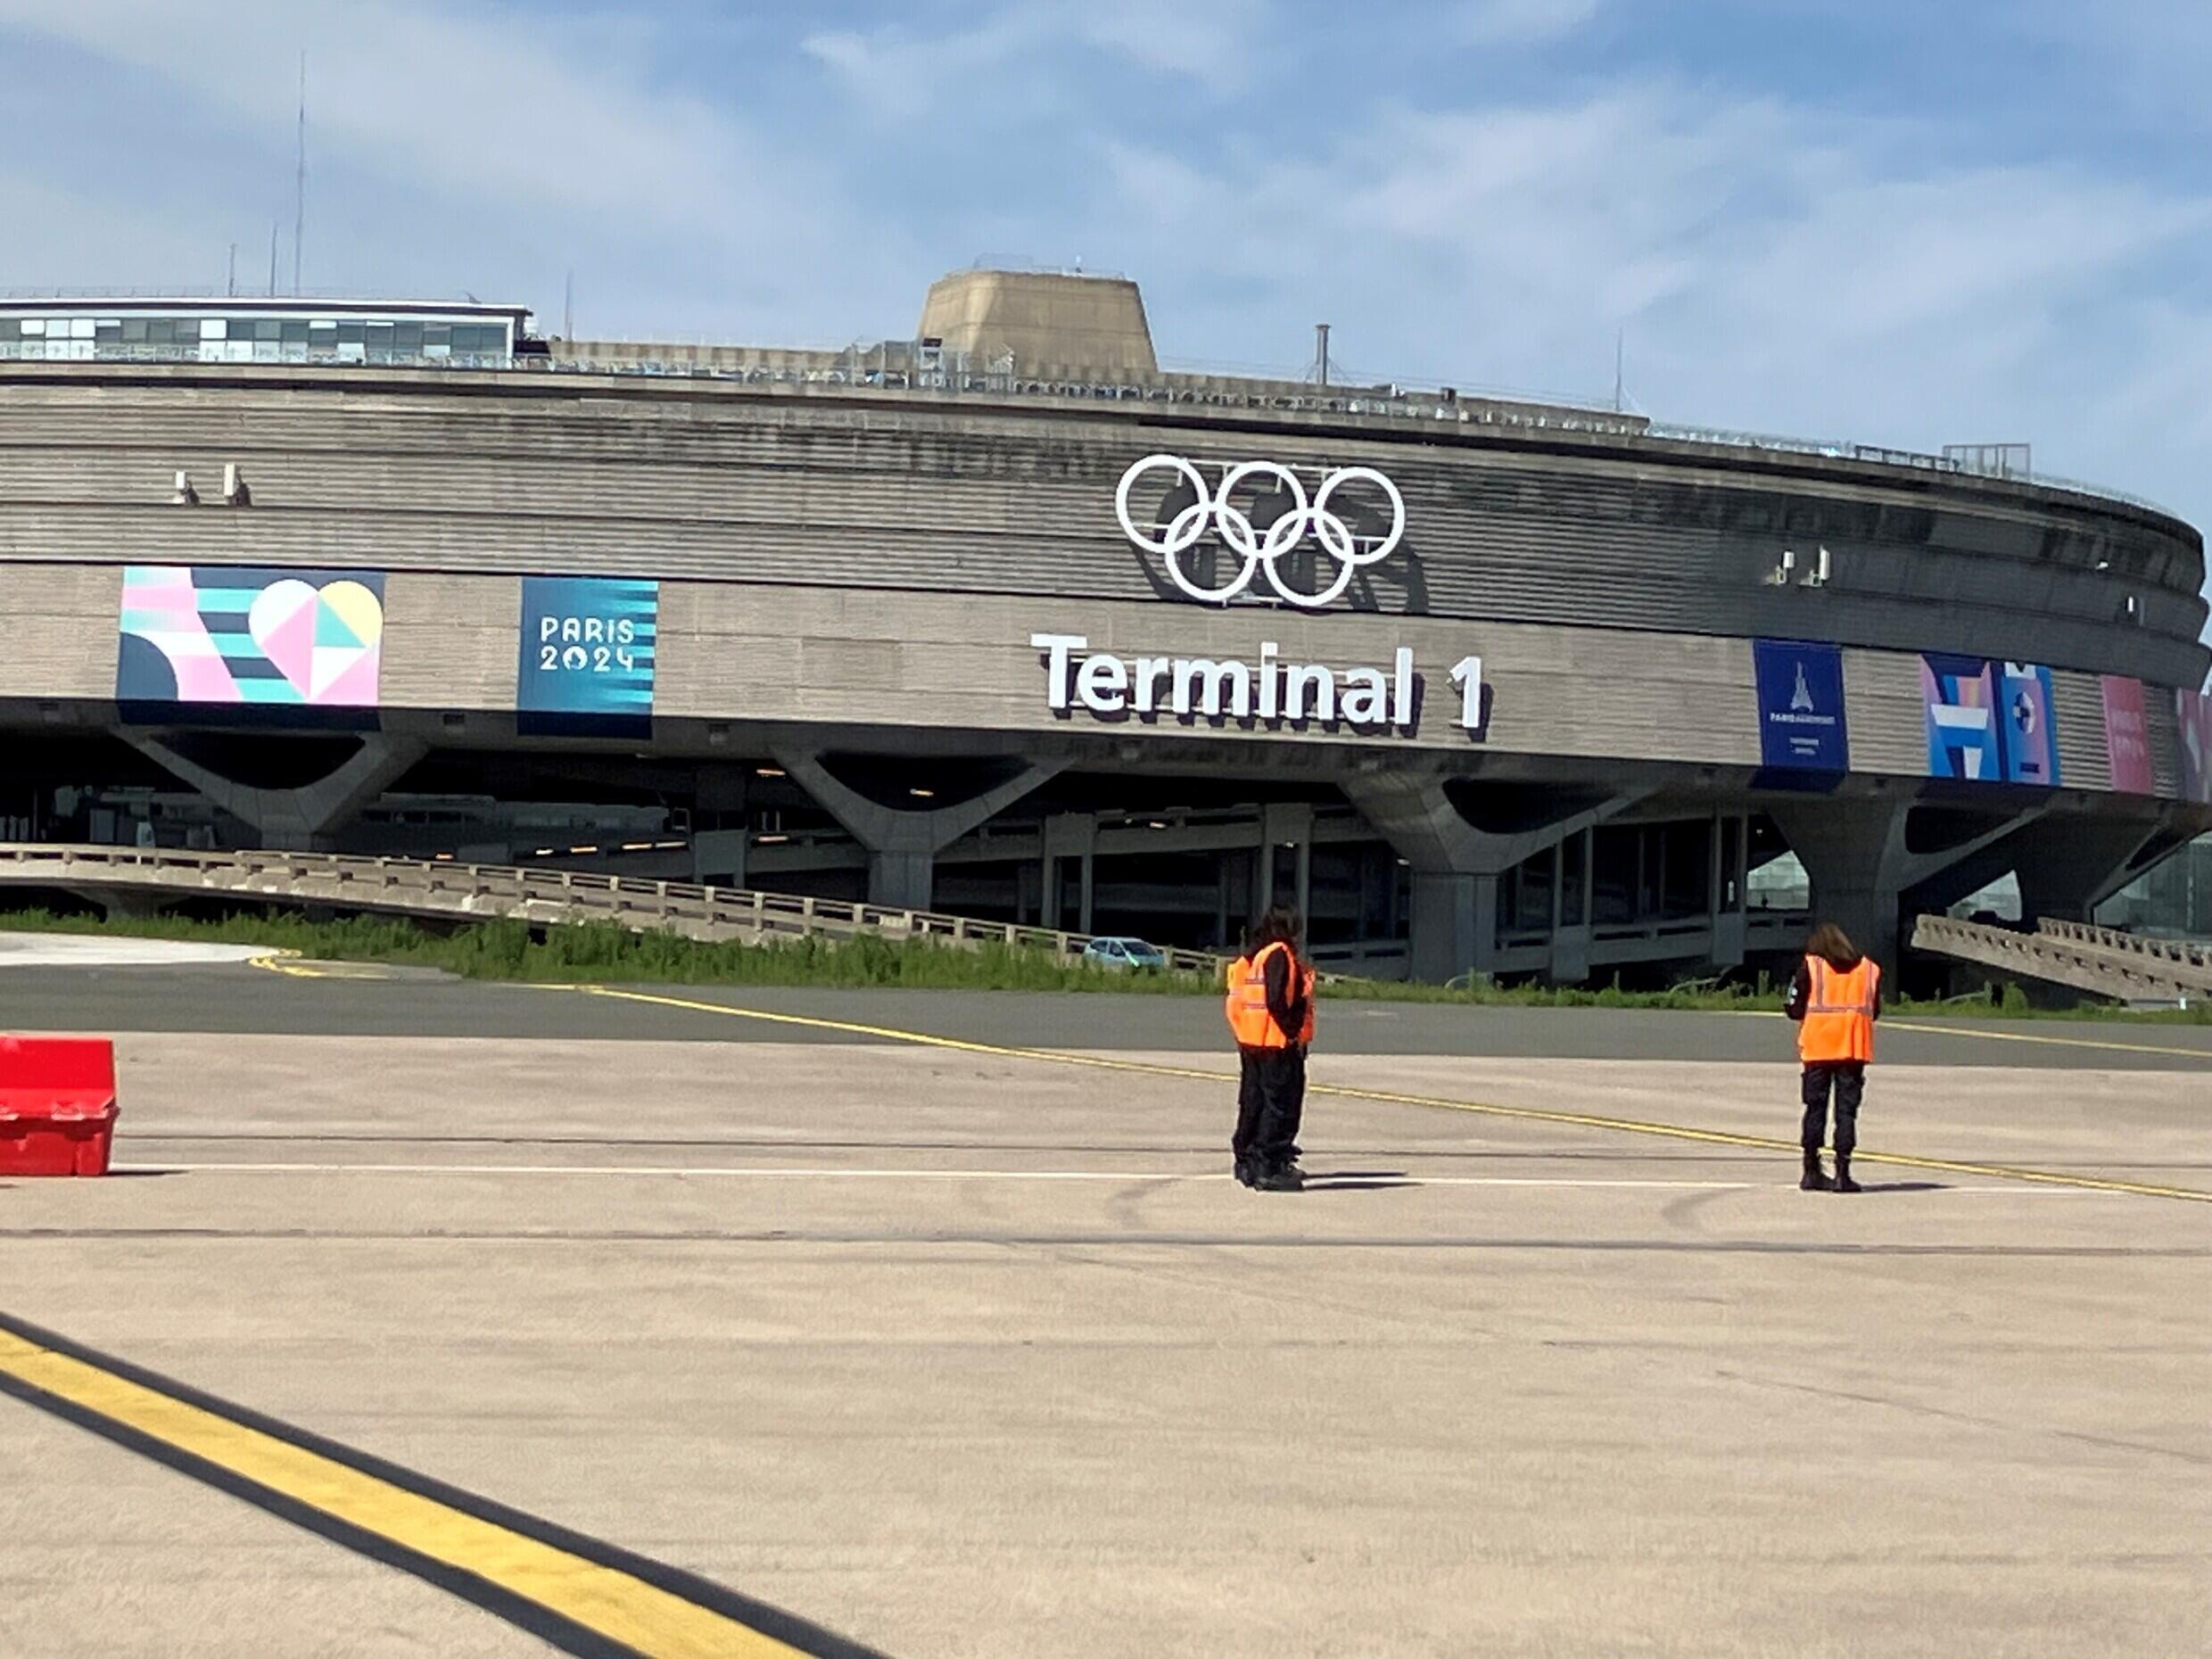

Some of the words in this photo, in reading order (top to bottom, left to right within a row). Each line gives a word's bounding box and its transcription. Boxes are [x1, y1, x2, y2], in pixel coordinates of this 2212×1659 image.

[541, 616, 634, 643] PARIS
[541, 645, 633, 673] 2024
[1031, 633, 1414, 725] Terminal
[1448, 656, 1482, 728] 1
